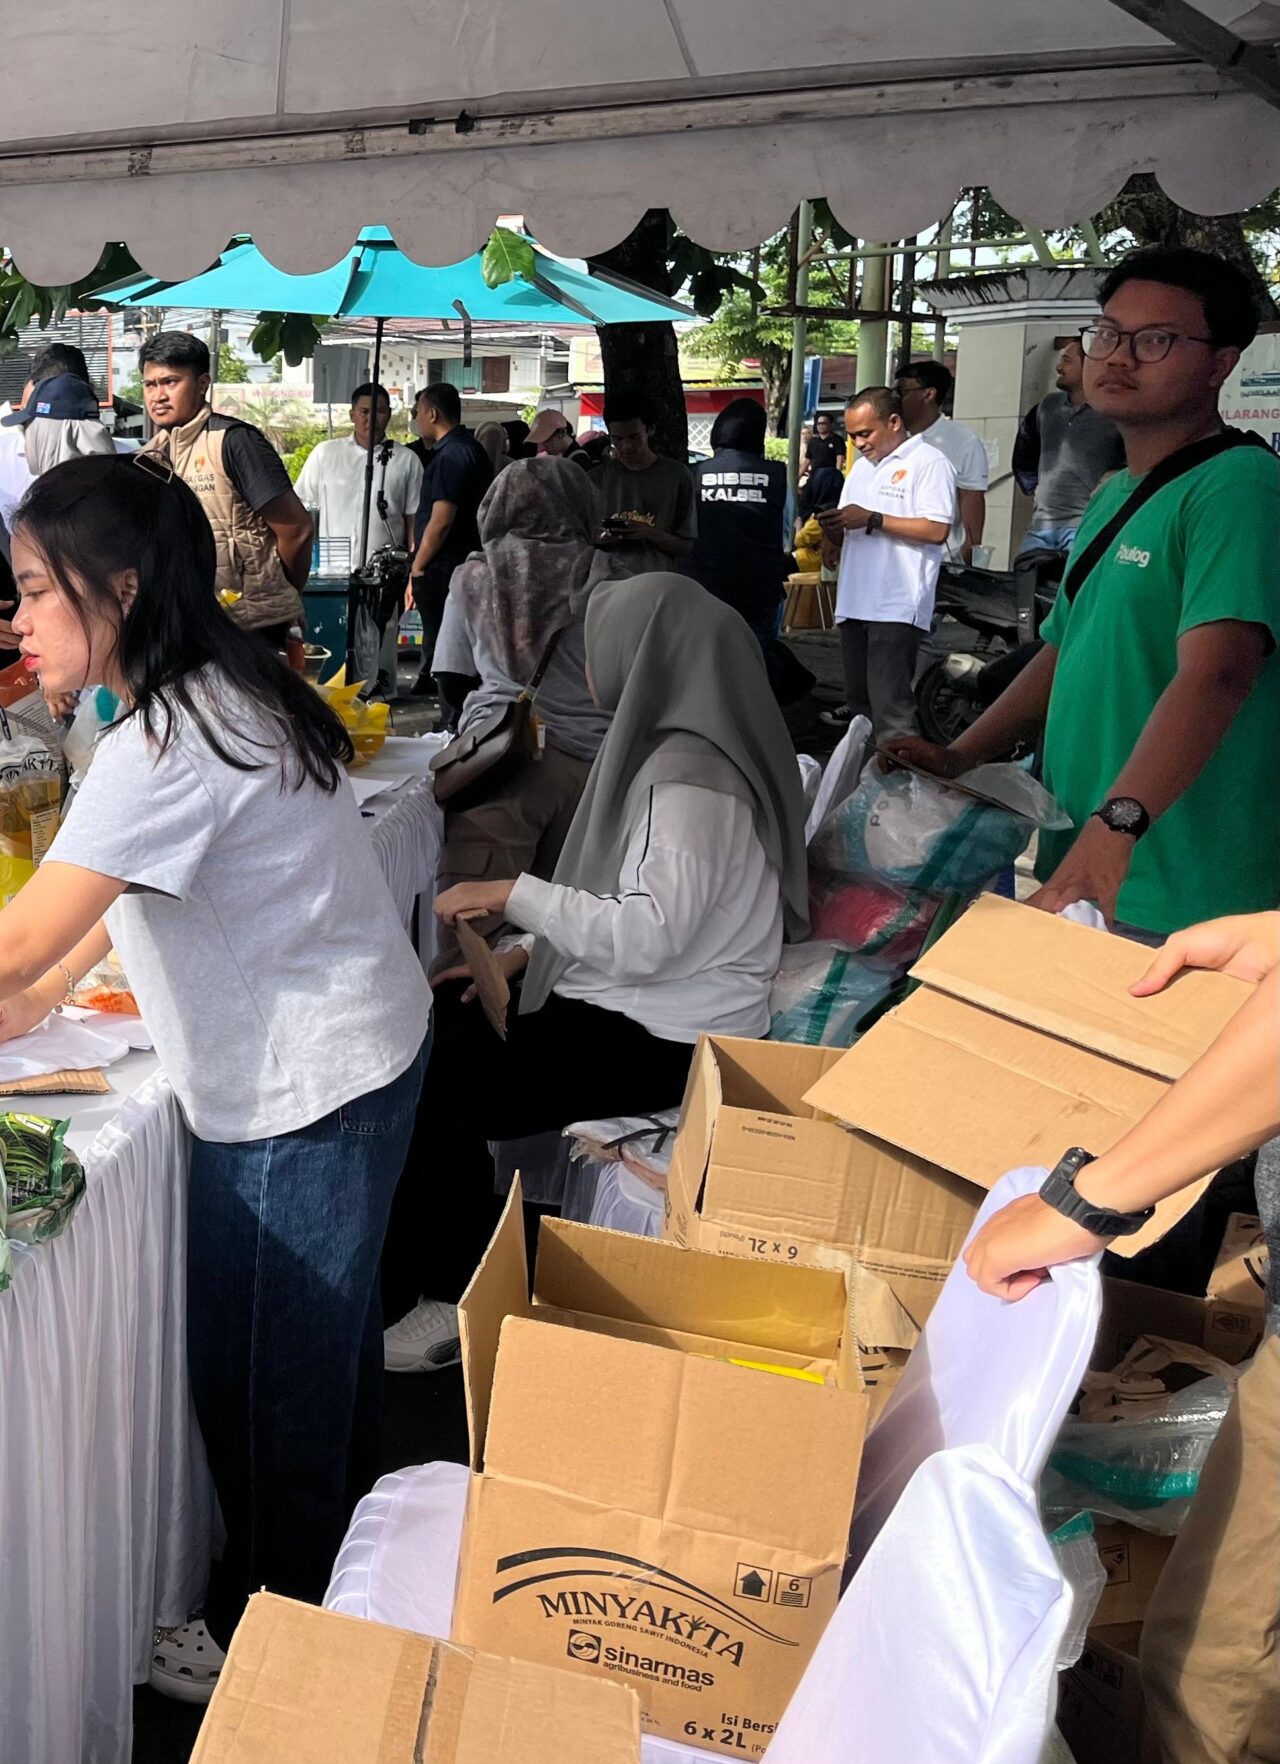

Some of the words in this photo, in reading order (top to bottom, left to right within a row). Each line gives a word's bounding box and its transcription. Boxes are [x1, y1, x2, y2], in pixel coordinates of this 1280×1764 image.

[701, 472, 769, 487] SIBER
[701, 488, 767, 503] KALSEL
[748, 1237, 767, 1254] 2L
[787, 1245, 799, 1260] 6
[787, 1578, 801, 1593] 6
[572, 1618, 603, 1626] MINYAK
[604, 1620, 638, 1632] GORENG
[639, 1626, 665, 1639] SAWIT
[665, 1635, 708, 1658] INDONESIA
[604, 1645, 715, 1687] sinarmas
[603, 1661, 660, 1682] agribusiness
[661, 1675, 680, 1687] and
[680, 1680, 703, 1693] food
[721, 1712, 738, 1727] Isi
[742, 1718, 779, 1734] Bersi
[683, 1721, 697, 1736] 6
[701, 1727, 716, 1741] x
[719, 1728, 747, 1749] 2L
